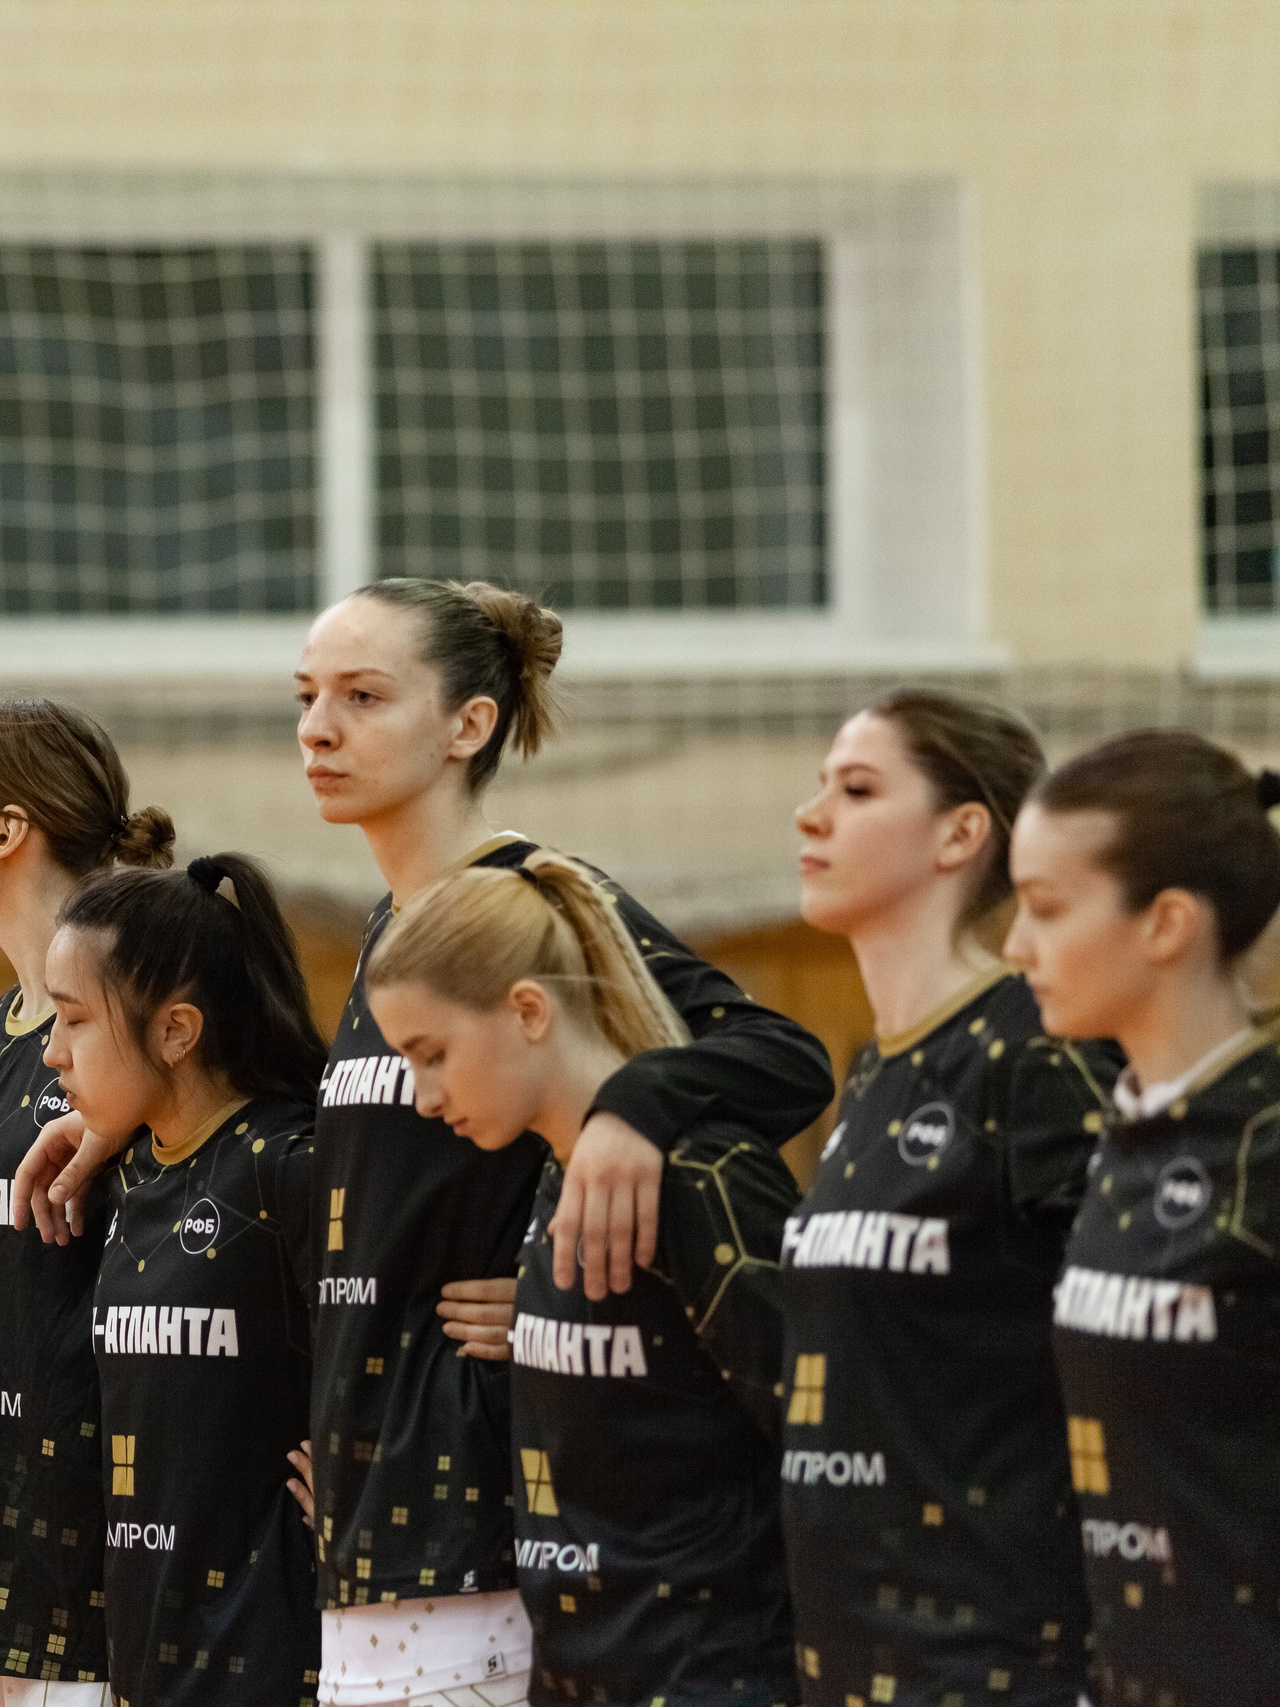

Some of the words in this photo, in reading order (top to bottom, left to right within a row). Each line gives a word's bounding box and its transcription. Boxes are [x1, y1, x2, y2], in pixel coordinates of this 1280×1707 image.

[320, 1056, 415, 1107] -АТЛАНТ
[39, 1095, 71, 1112] РФБ
[184, 1218, 215, 1234] РФБ
[92, 1306, 239, 1357] -АТЛАНТА
